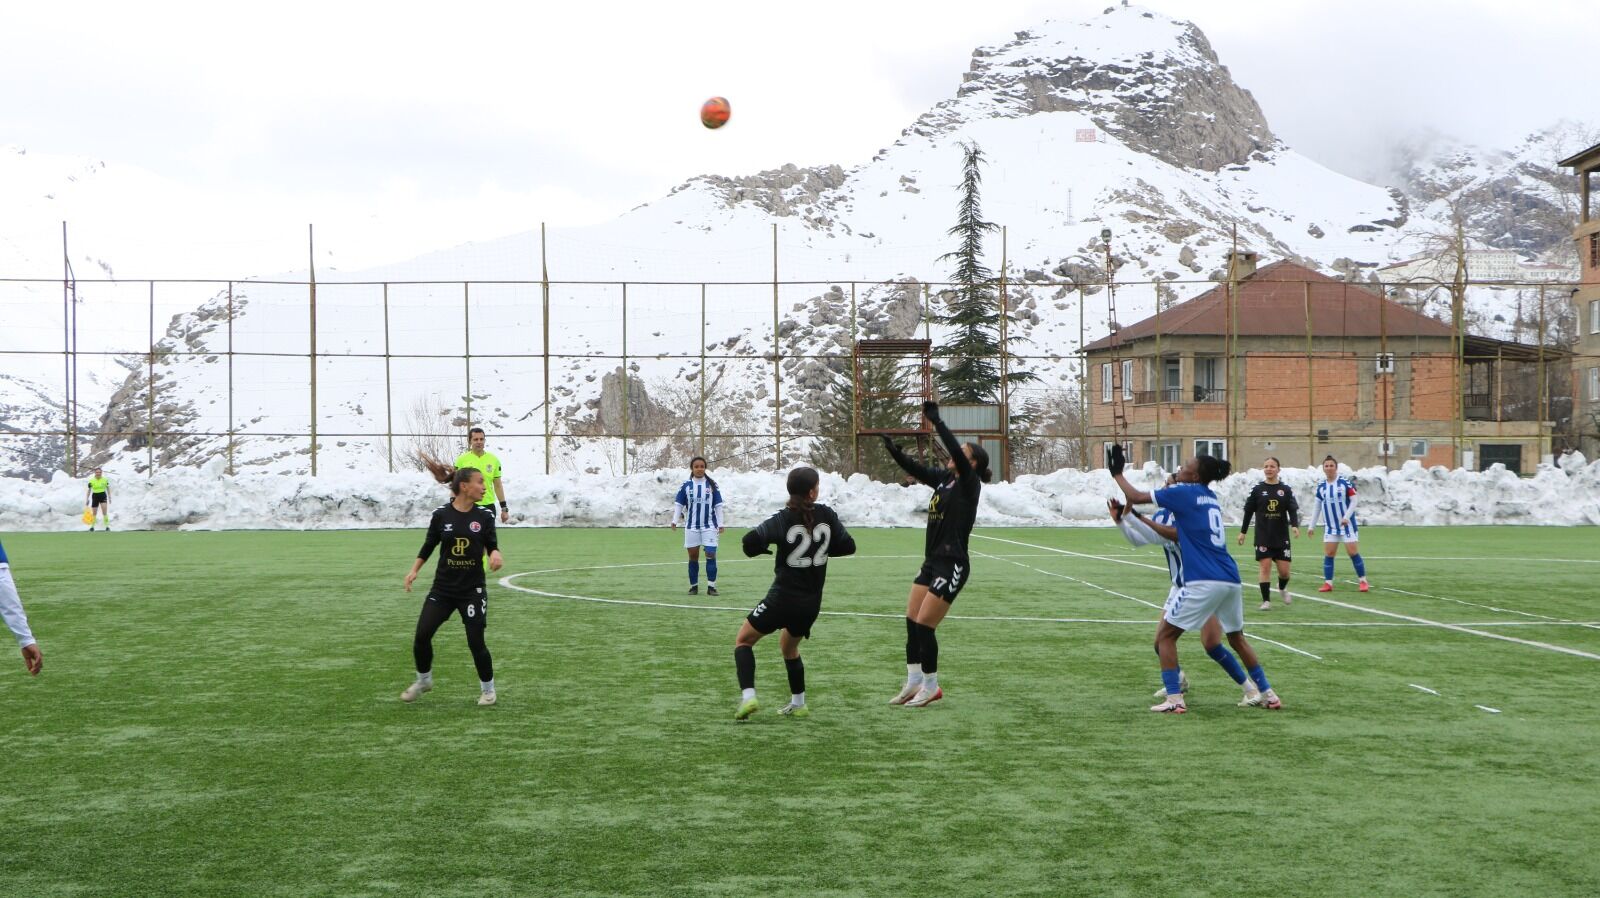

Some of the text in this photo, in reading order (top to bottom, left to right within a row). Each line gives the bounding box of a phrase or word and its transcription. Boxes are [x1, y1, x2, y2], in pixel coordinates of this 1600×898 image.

[1208, 507, 1224, 547] 9
[786, 523, 831, 568] 22
[933, 576, 947, 590] 17
[467, 604, 476, 618] 6
